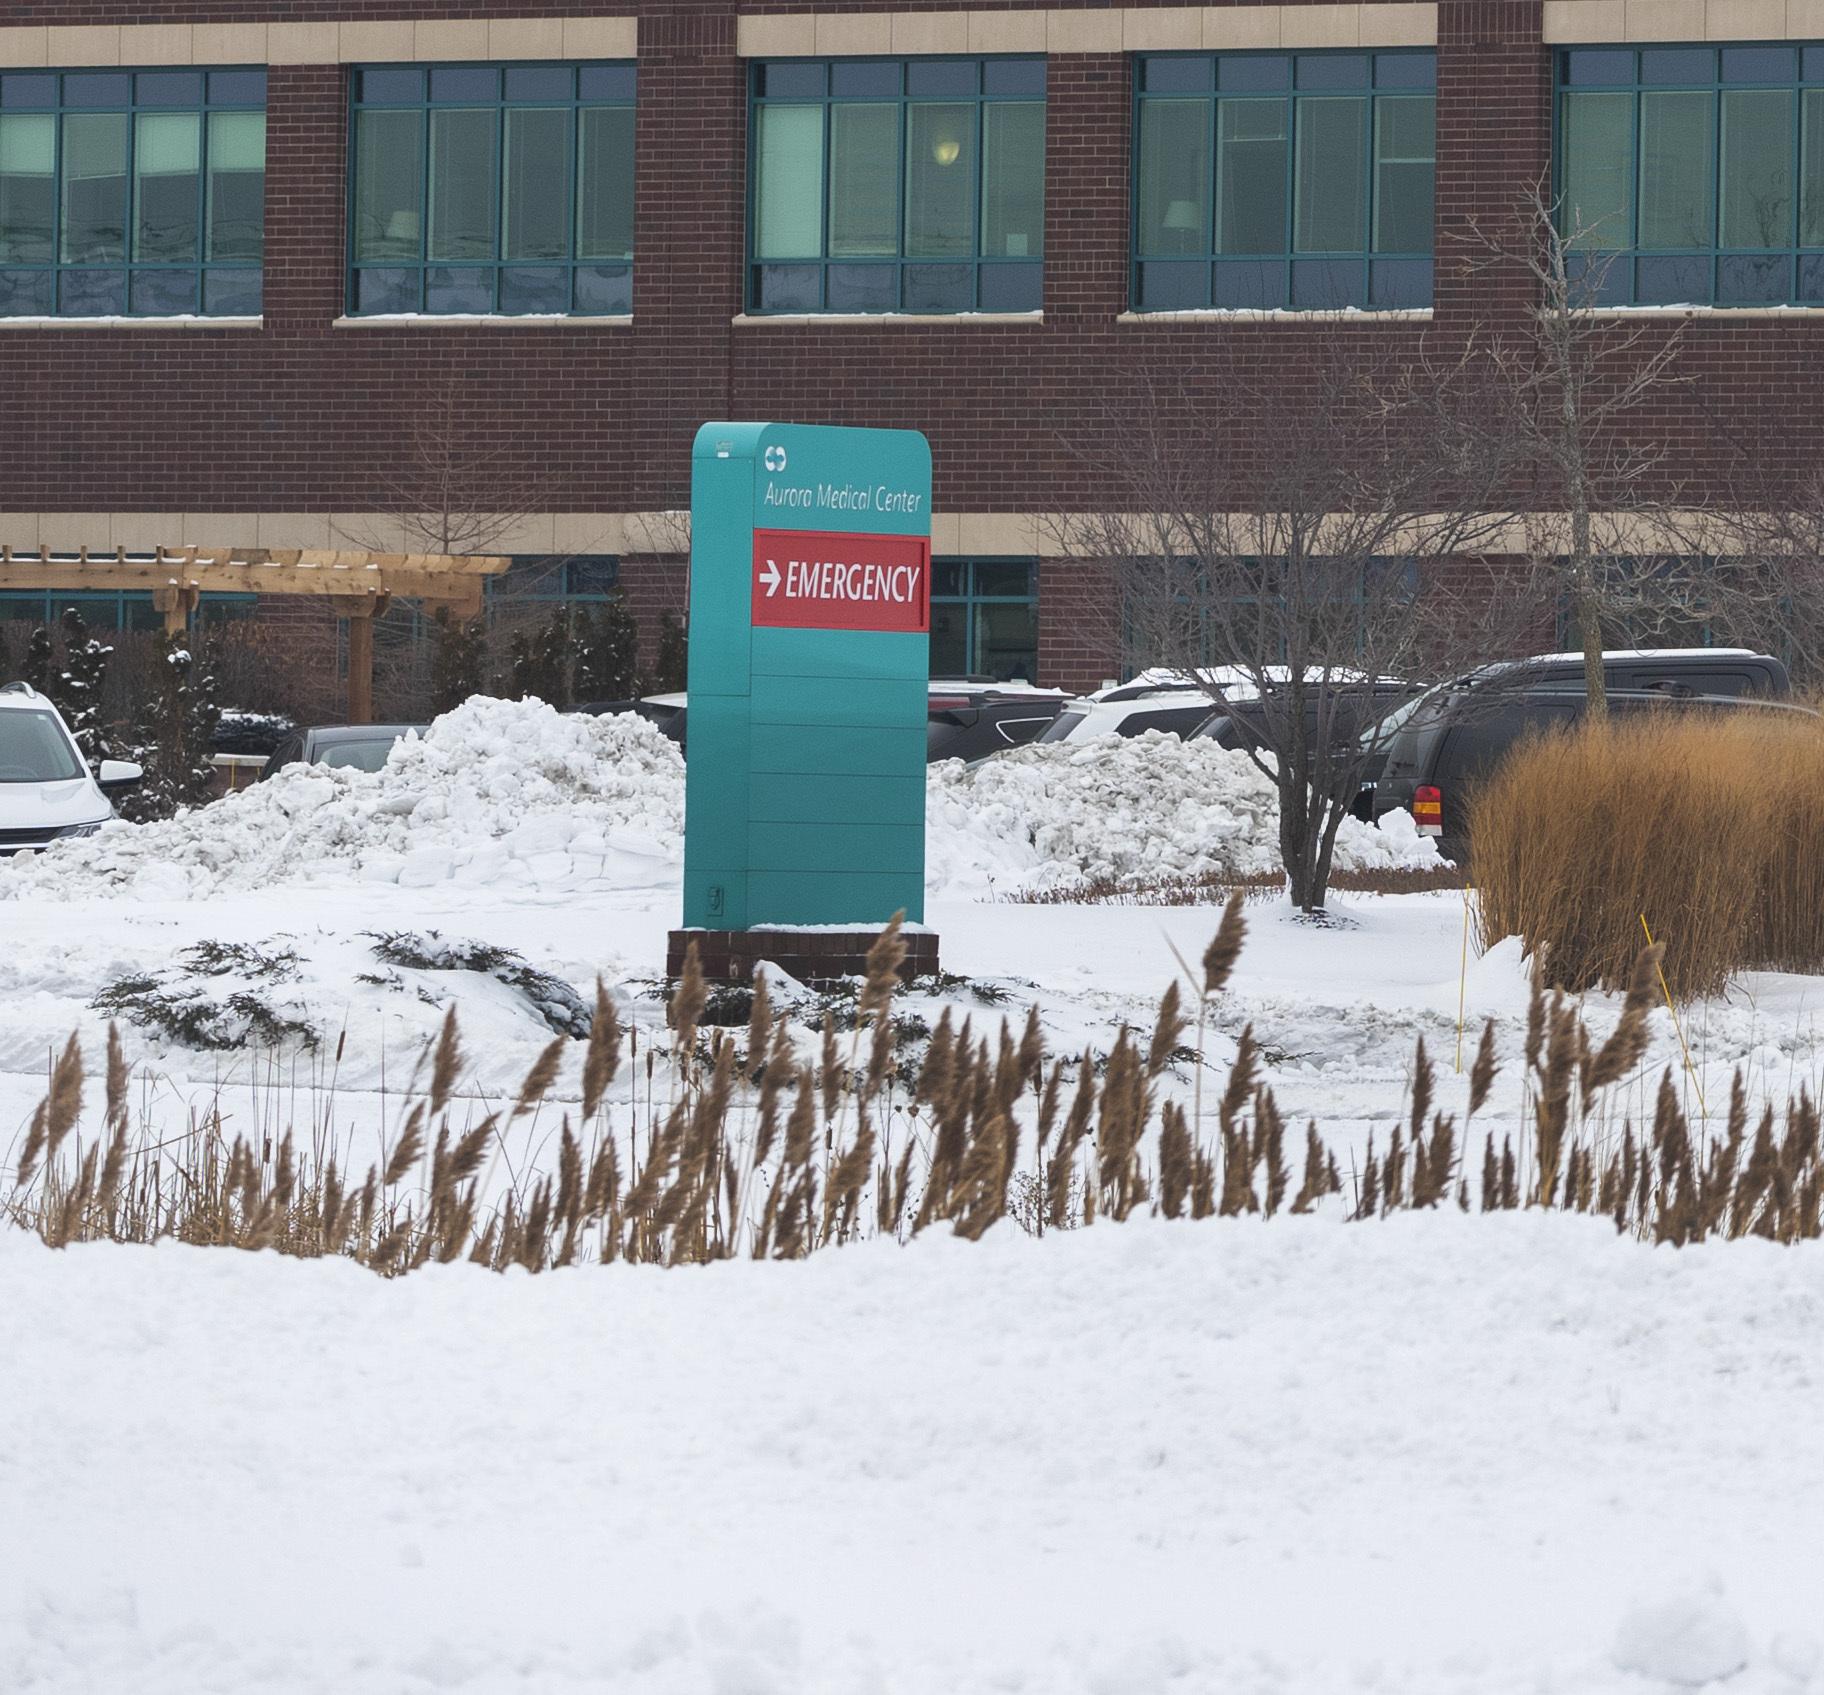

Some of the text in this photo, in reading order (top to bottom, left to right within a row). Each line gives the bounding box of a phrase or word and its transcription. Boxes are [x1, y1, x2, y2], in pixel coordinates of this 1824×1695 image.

[764, 481, 922, 513] Aurora Medical Center
[785, 560, 921, 603] EMERGENCY
